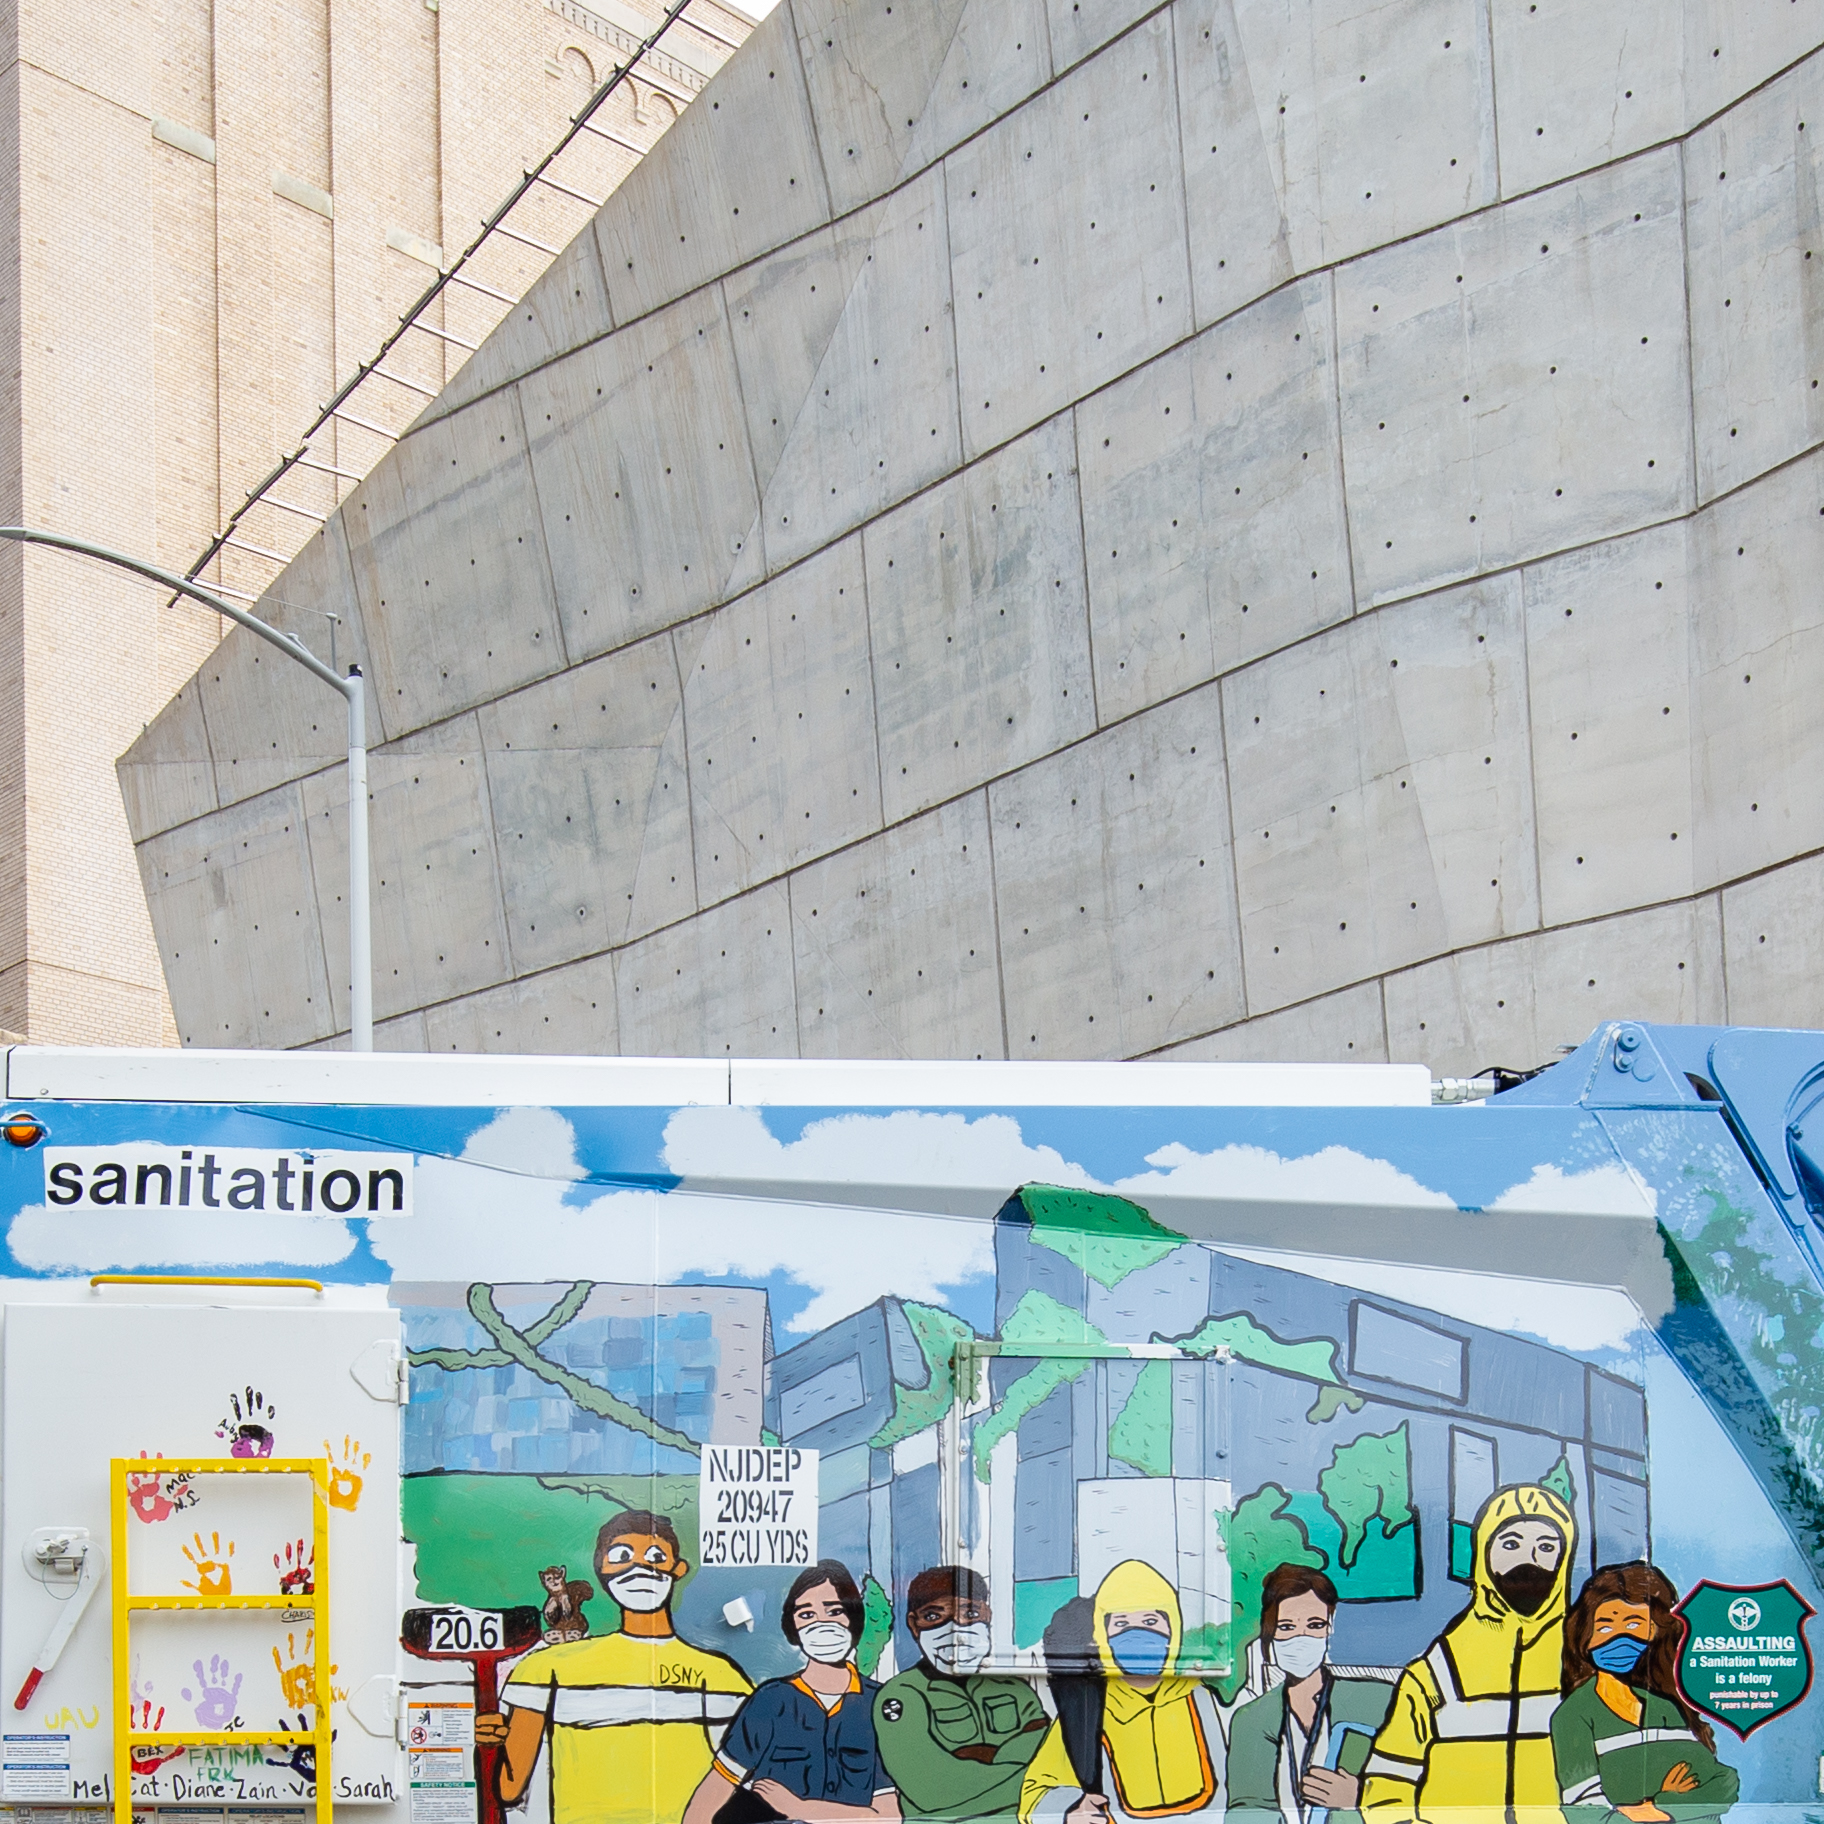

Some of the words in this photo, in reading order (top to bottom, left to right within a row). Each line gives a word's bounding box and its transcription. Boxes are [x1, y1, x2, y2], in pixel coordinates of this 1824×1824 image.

[47, 1150, 404, 1213] sanitation
[710, 1449, 801, 1482] NJDEP
[717, 1489, 794, 1523] 20947
[703, 1530, 727, 1564] 25
[731, 1529, 760, 1564] CU
[766, 1529, 809, 1564] YDS
[435, 1616, 499, 1649] 20.6
[1692, 1636, 1796, 1651] ASSAULTING
[1689, 1658, 1697, 1667] a
[1700, 1655, 1756, 1668] Sanitation
[1758, 1655, 1798, 1667] Worker
[660, 1664, 704, 1685] DSNY
[1715, 1672, 1725, 1684] is
[1728, 1674, 1736, 1684] a
[1738, 1672, 1773, 1686] felony
[1709, 1691, 1749, 1699] punishable
[1749, 1691, 1759, 1699] by
[189, 1744, 266, 1767] FATIMA
[74, 1773, 110, 1798] Mel
[175, 1774, 226, 1800] Diane
[236, 1778, 278, 1800] Zain
[336, 1776, 396, 1800] Sarah
